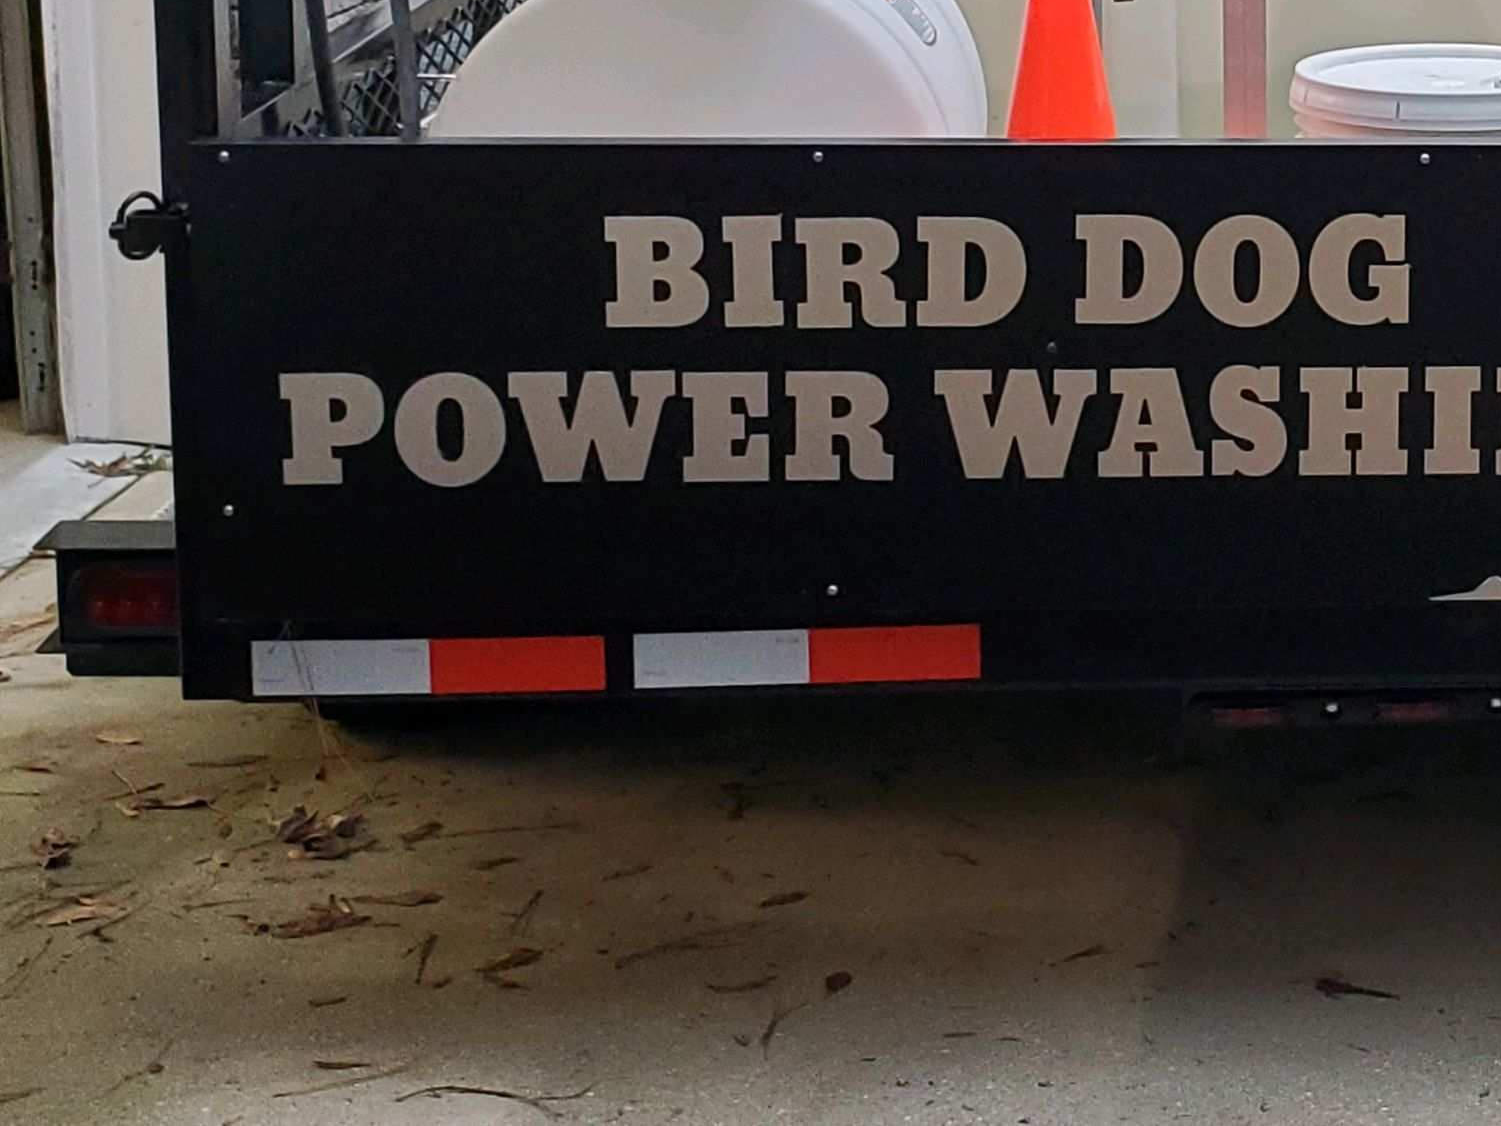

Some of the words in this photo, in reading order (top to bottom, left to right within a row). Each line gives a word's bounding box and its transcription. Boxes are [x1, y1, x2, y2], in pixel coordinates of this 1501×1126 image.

[604, 214, 1027, 329] BIRD
[1074, 212, 1411, 328] DOG
[279, 369, 894, 488] POWER
